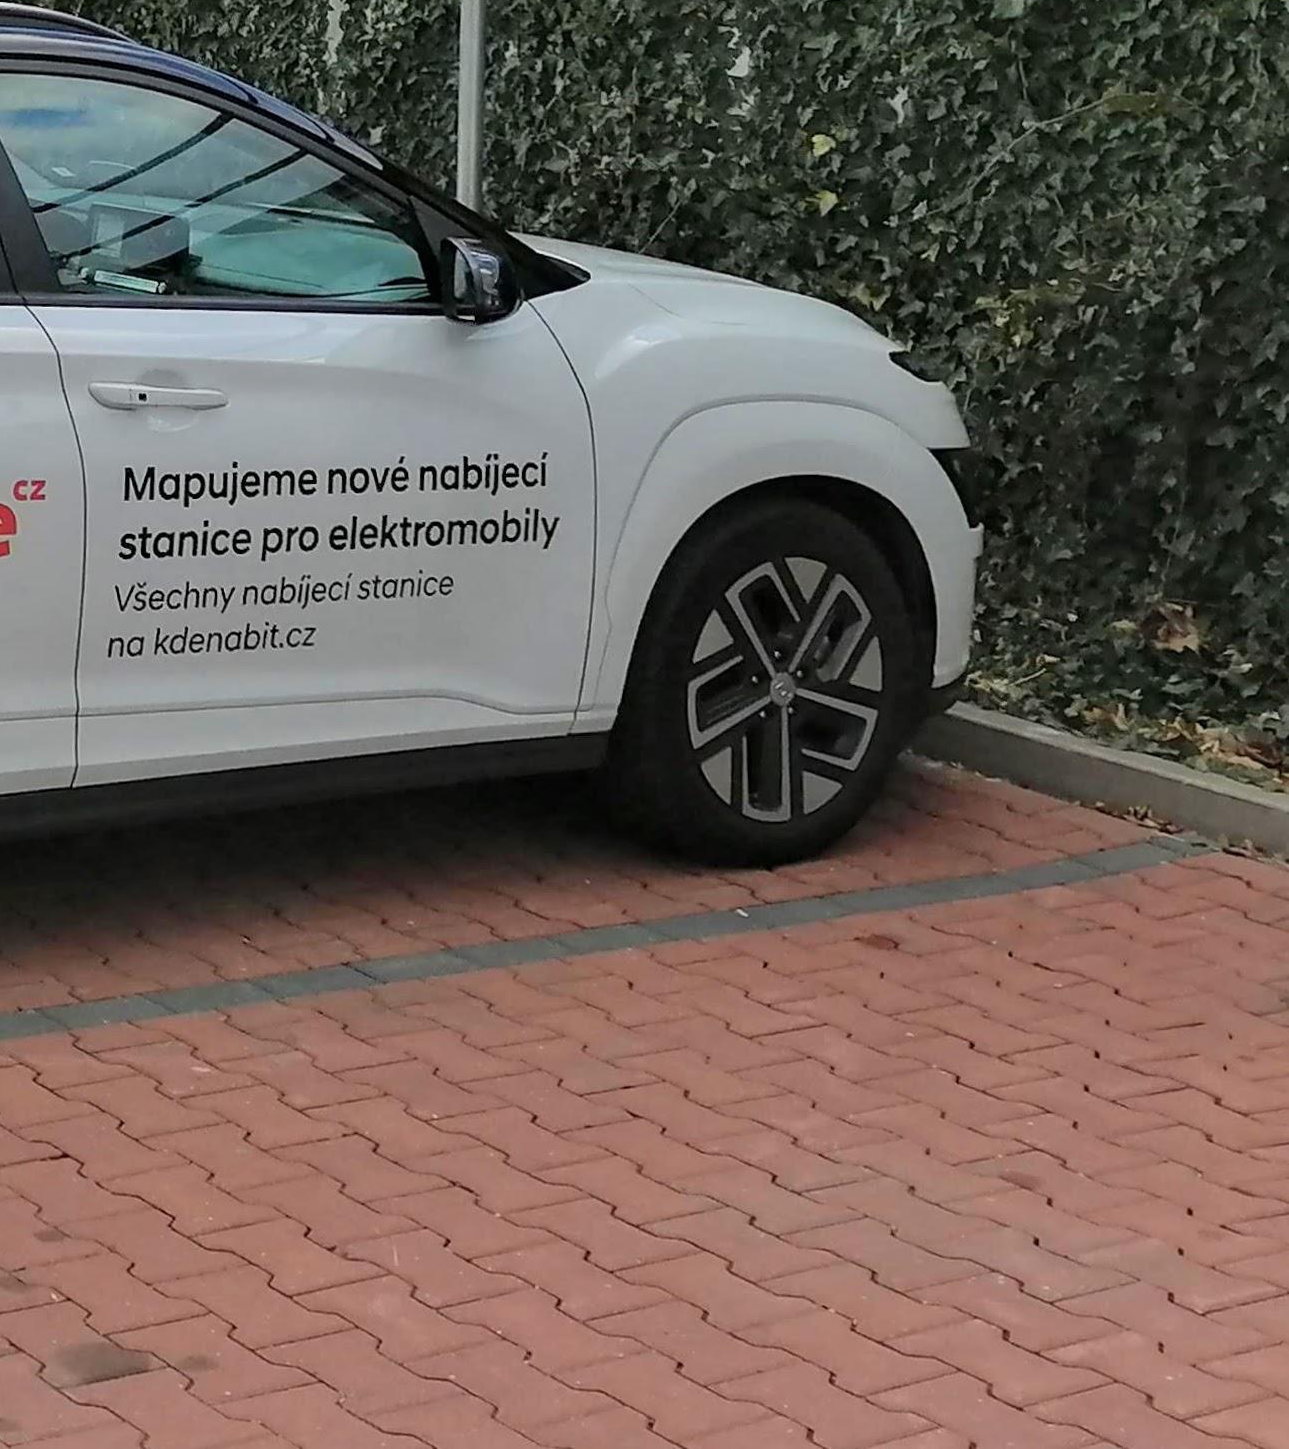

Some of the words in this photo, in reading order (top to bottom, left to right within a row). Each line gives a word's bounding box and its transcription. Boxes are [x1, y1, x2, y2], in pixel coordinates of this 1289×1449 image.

[124, 461, 318, 508] Mapujeme
[327, 456, 410, 494] nové
[419, 452, 549, 496] nabíjecí
[118, 520, 252, 560] stanice
[261, 526, 319, 562] pro
[329, 507, 560, 550] elektromobily
[115, 581, 235, 614] Všechny
[242, 572, 353, 610] nabíjecí
[357, 569, 454, 600] stanice
[107, 636, 145, 658] na
[154, 621, 317, 656] kdenabit.cz
